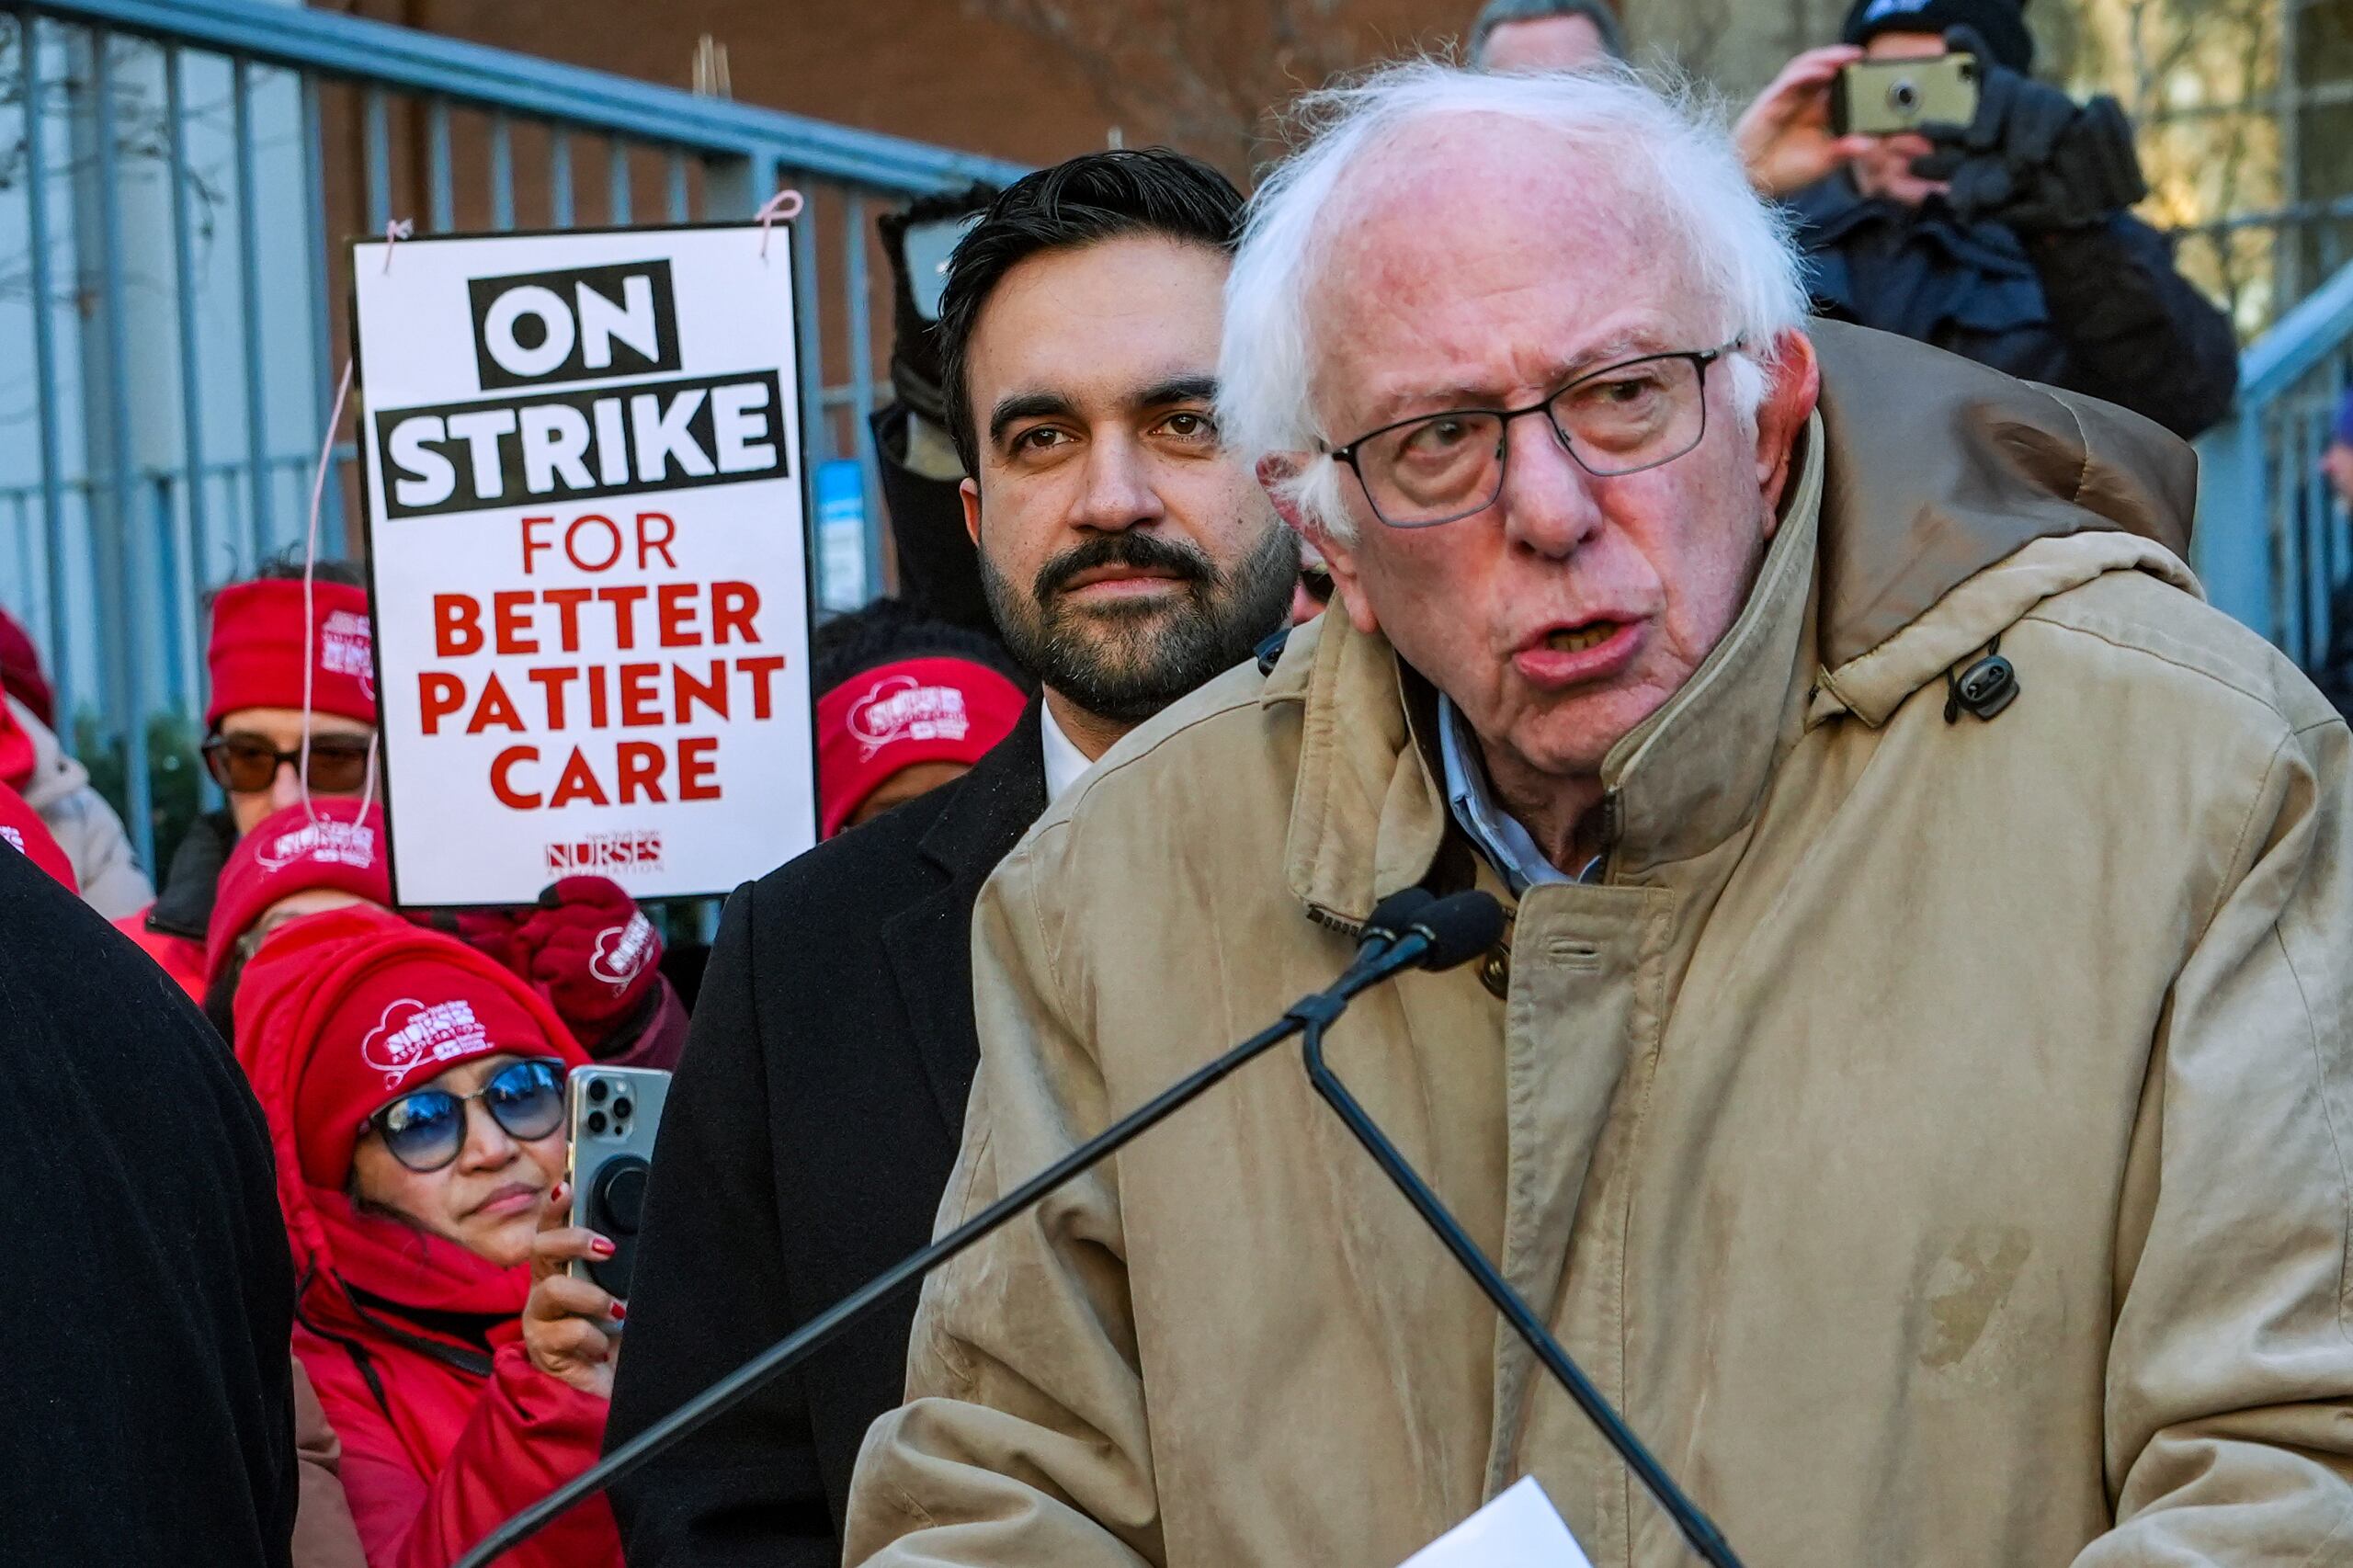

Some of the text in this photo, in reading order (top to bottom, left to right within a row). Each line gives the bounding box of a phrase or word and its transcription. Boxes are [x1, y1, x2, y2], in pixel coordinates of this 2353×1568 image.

[483, 276, 660, 377] ON
[388, 382, 778, 507] STRIKE
[521, 513, 676, 575] FOR
[433, 582, 762, 657] BETTER
[417, 656, 785, 735] PATIENT
[489, 737, 722, 810] CARE
[546, 839, 662, 869] NURSES
